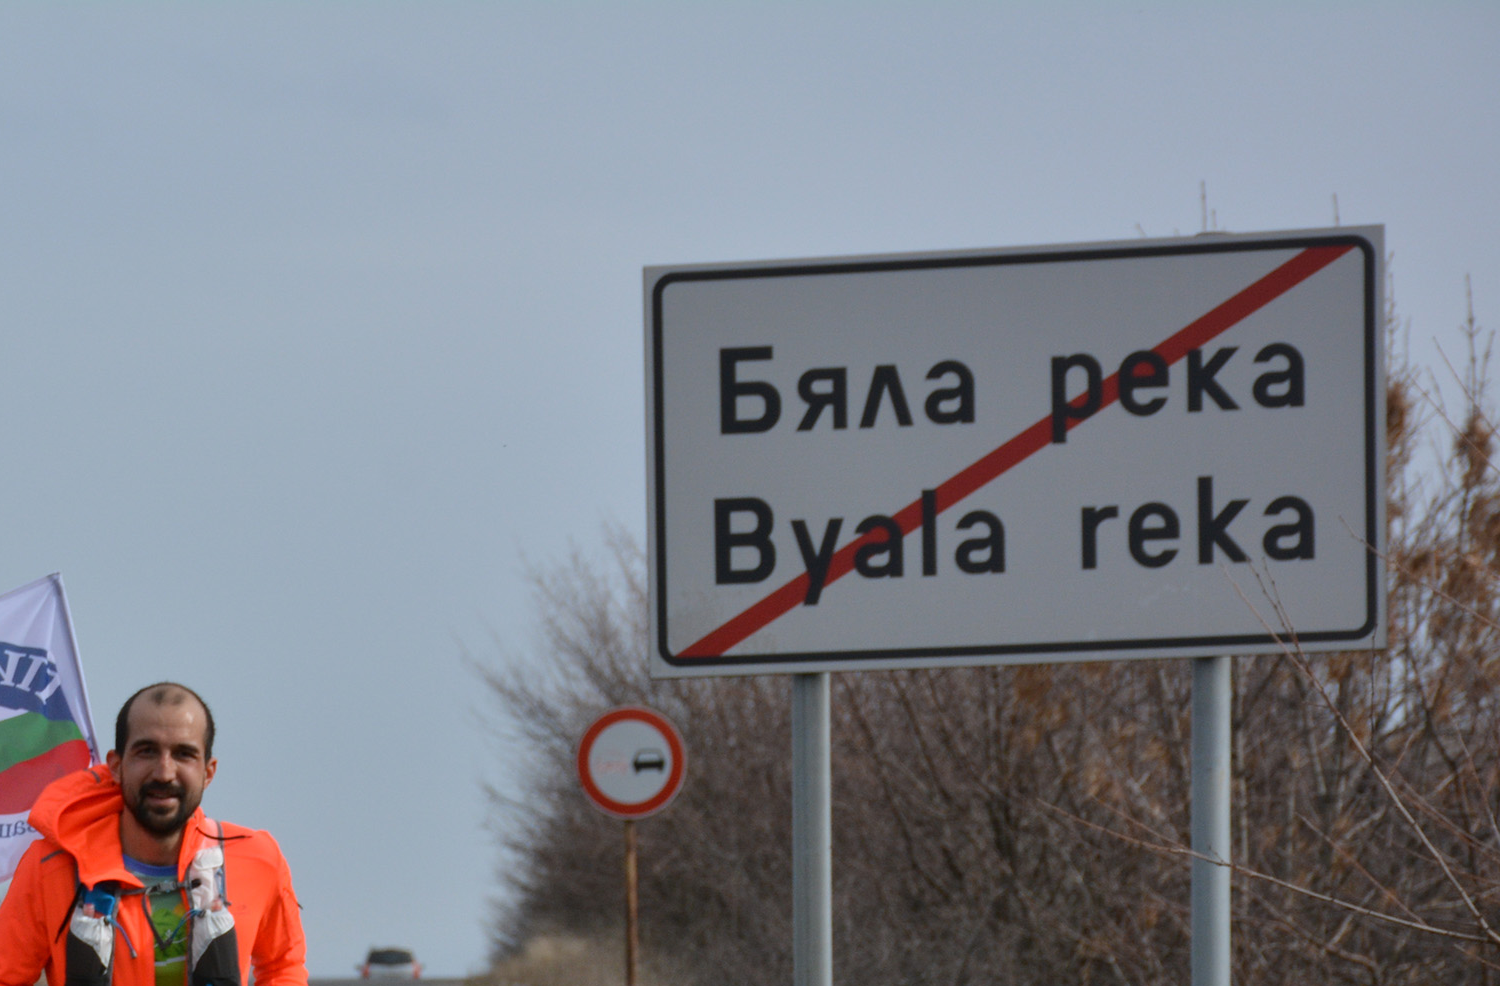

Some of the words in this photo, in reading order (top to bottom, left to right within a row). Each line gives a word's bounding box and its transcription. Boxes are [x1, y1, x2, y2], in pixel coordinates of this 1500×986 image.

[720, 346, 976, 435] Бяла
[1051, 343, 1306, 443] река
[714, 490, 1006, 606] Byala
[1082, 476, 1316, 571] reka
